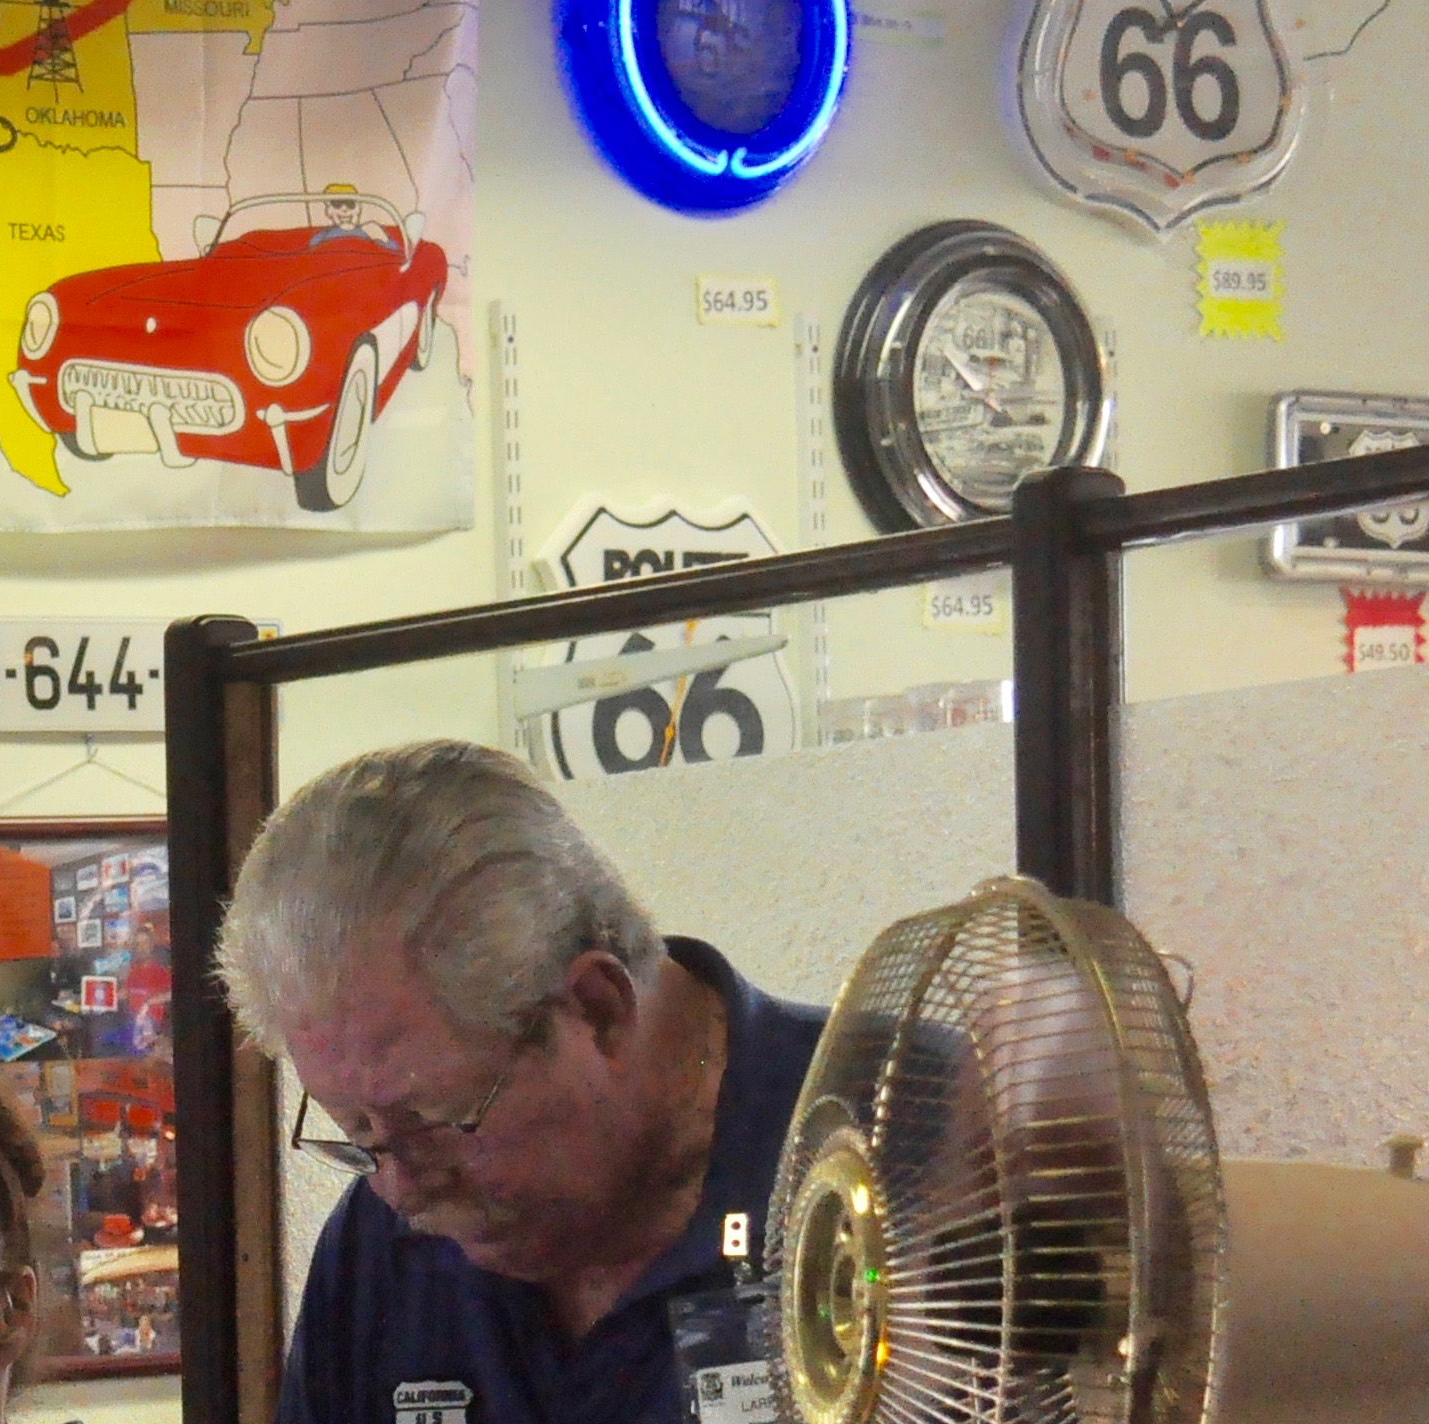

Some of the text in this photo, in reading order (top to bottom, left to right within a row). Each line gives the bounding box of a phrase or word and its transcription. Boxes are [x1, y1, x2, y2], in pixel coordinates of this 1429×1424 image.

[1100, 6, 1240, 141] 66
[25, 106, 126, 128] OKLAHOMA
[8, 222, 65, 242] TEXAS
[703, 288, 768, 313] $64.95
[932, 594, 993, 618] $64.95
